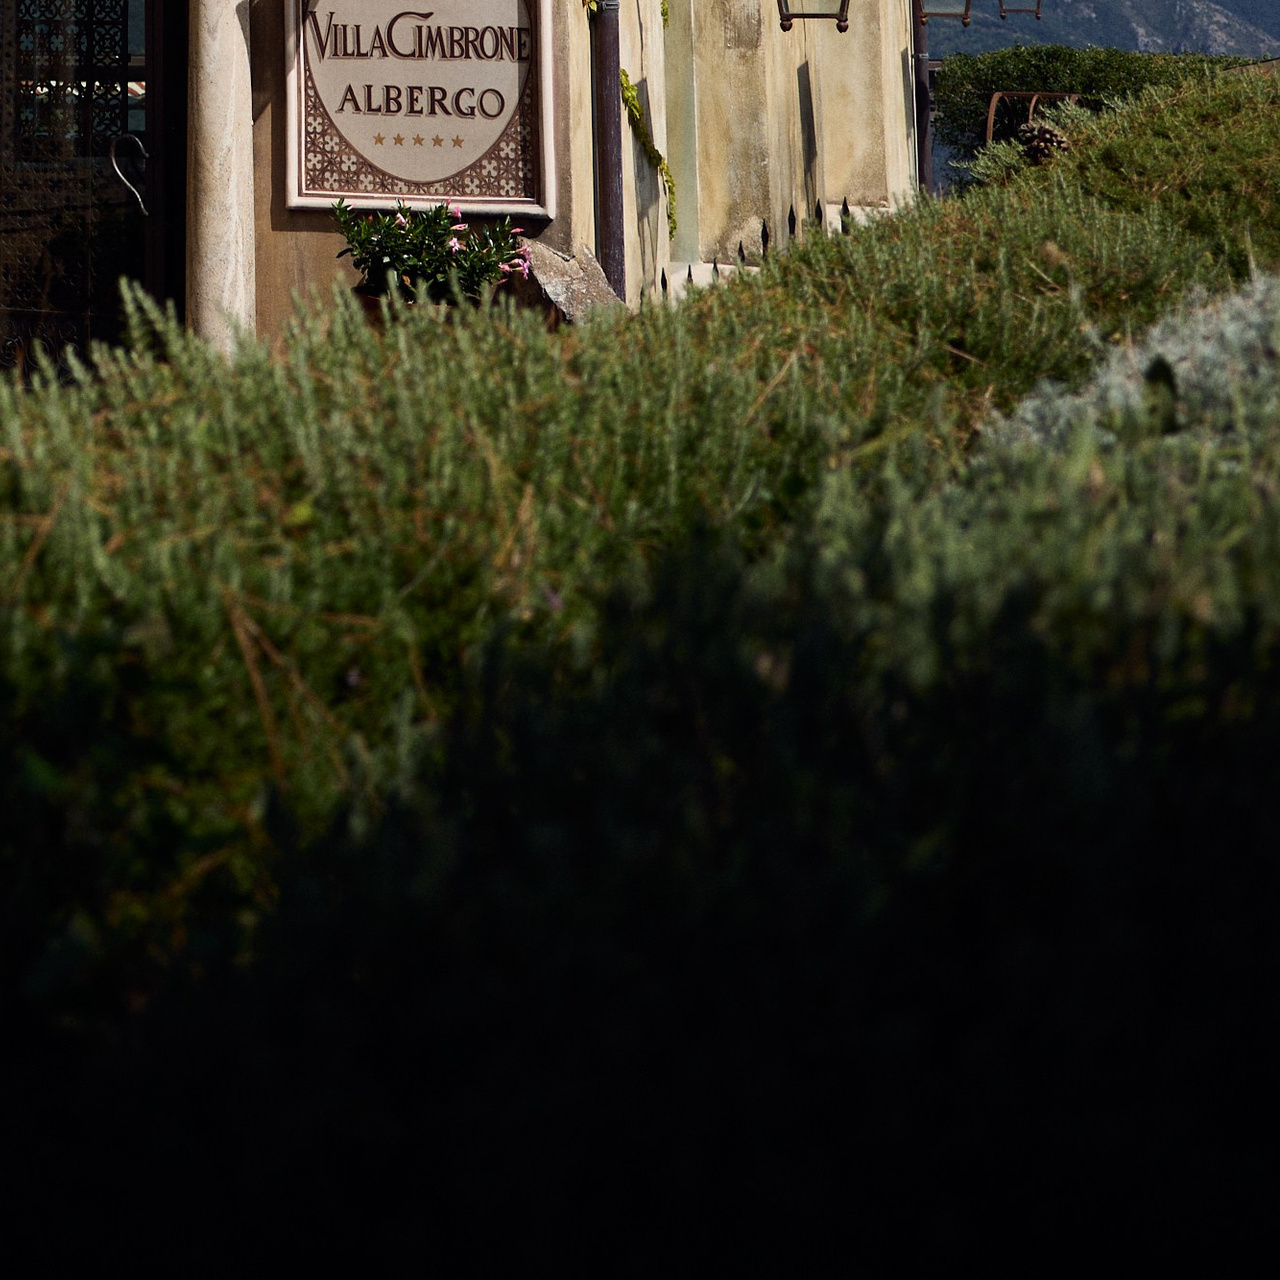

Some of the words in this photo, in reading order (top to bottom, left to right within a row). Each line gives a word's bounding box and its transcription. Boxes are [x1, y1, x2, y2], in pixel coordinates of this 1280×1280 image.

[307, 11, 389, 62] VILLA
[385, 11, 532, 62] CIMBRONE
[338, 84, 507, 118] ALBERGO
